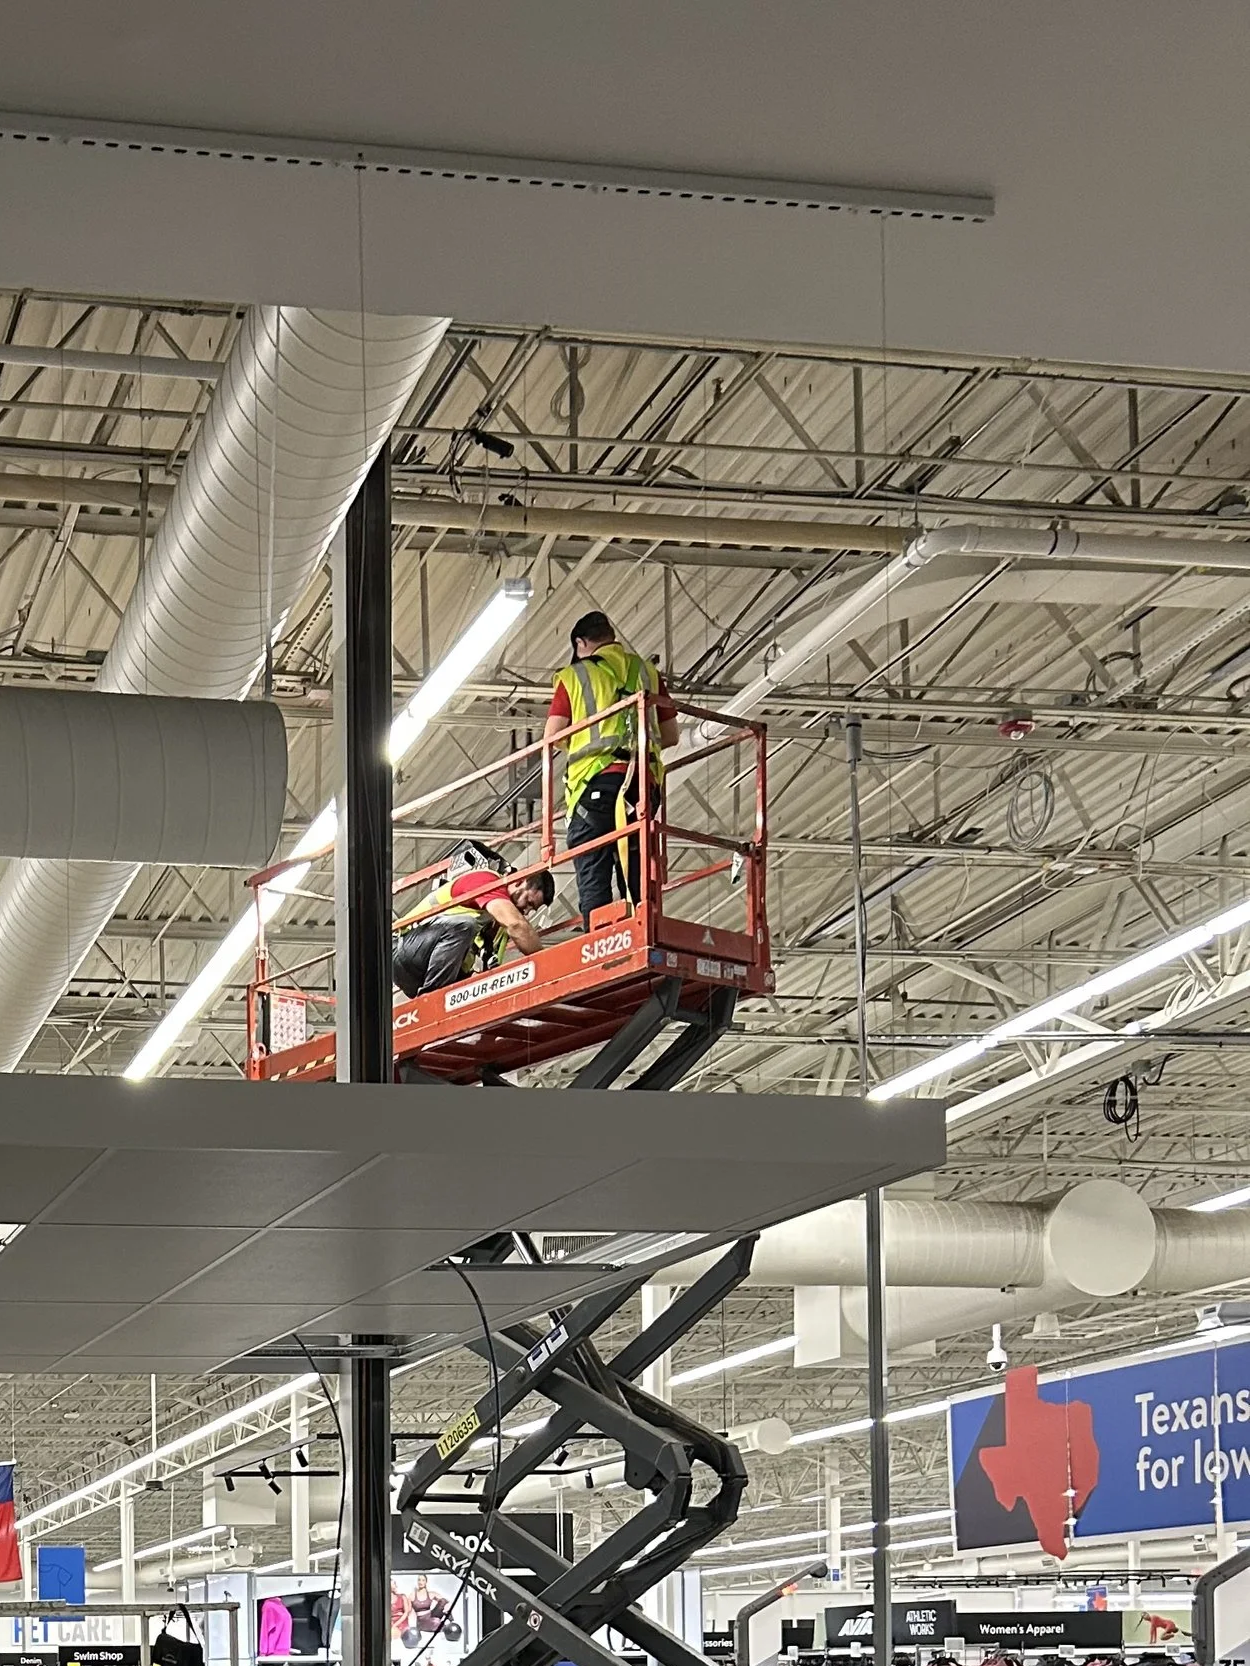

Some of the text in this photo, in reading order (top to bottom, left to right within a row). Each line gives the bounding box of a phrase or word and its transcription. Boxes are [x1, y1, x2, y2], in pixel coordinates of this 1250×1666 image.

[581, 930, 632, 964] SJ3226
[1135, 1389, 1250, 1437] Texans
[1136, 1446, 1185, 1491] for
[906, 1609, 937, 1623] ATHLETIC
[57, 1617, 113, 1643] CARE
[909, 1623, 935, 1636] WORKS
[979, 1623, 1065, 1636] Women's Apparel
[20, 1656, 43, 1665] Denim
[73, 1651, 124, 1662] Swim Shop
